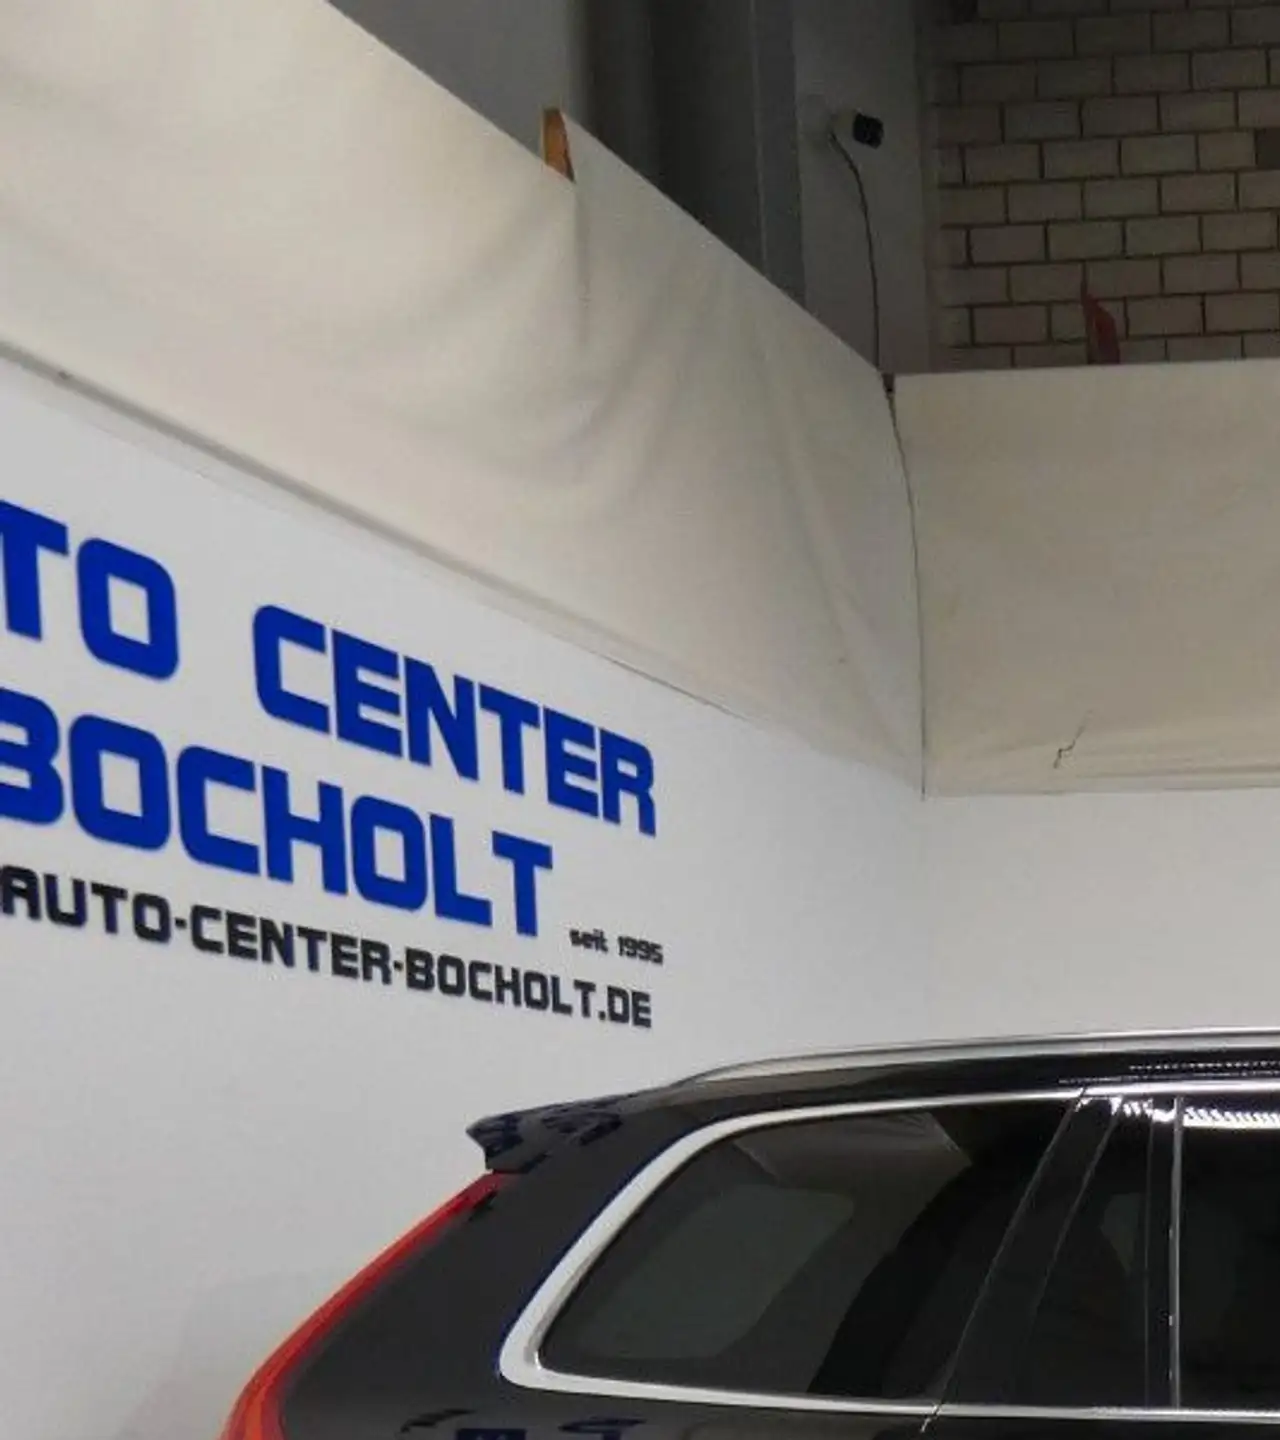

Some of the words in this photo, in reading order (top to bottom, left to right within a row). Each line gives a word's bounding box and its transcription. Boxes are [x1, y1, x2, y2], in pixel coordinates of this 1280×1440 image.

[0, 688, 553, 937] BOCHOLT
[617, 935, 664, 965] 1995
[253, 605, 656, 836] CENTER
